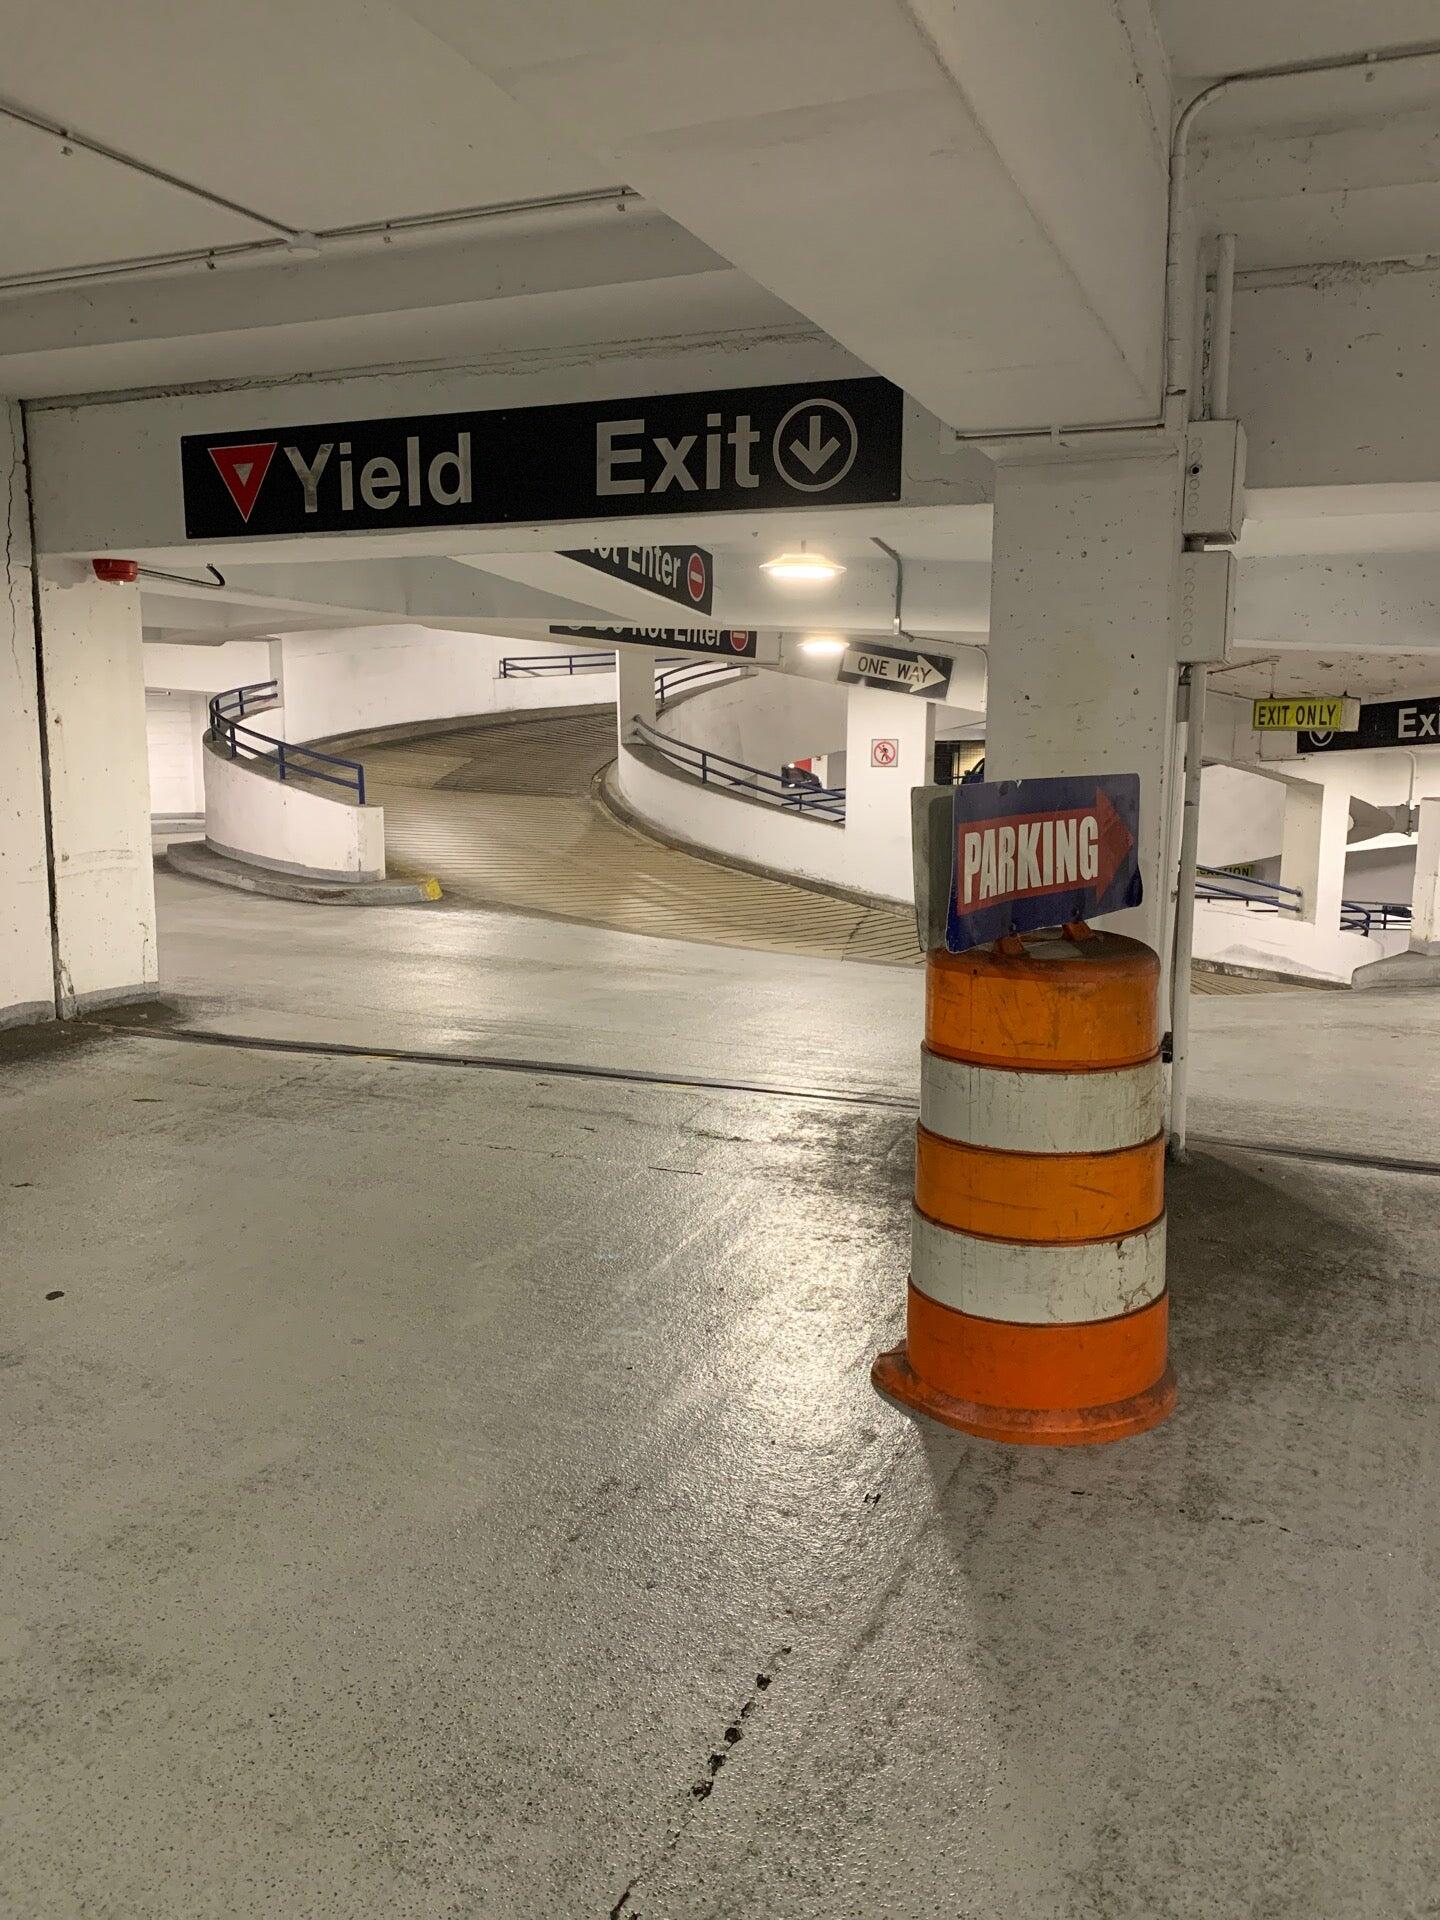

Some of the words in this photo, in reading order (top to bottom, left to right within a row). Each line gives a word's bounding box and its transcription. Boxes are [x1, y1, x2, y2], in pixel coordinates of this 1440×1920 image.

[283, 432, 472, 514] Yield
[596, 413, 760, 496] Exit
[627, 546, 681, 588] Enter
[858, 656, 890, 676] ONE
[897, 663, 932, 684] WAY
[1258, 705, 1290, 725] EXIT
[1295, 704, 1337, 726] ONLY
[963, 815, 1099, 904] PARKING
